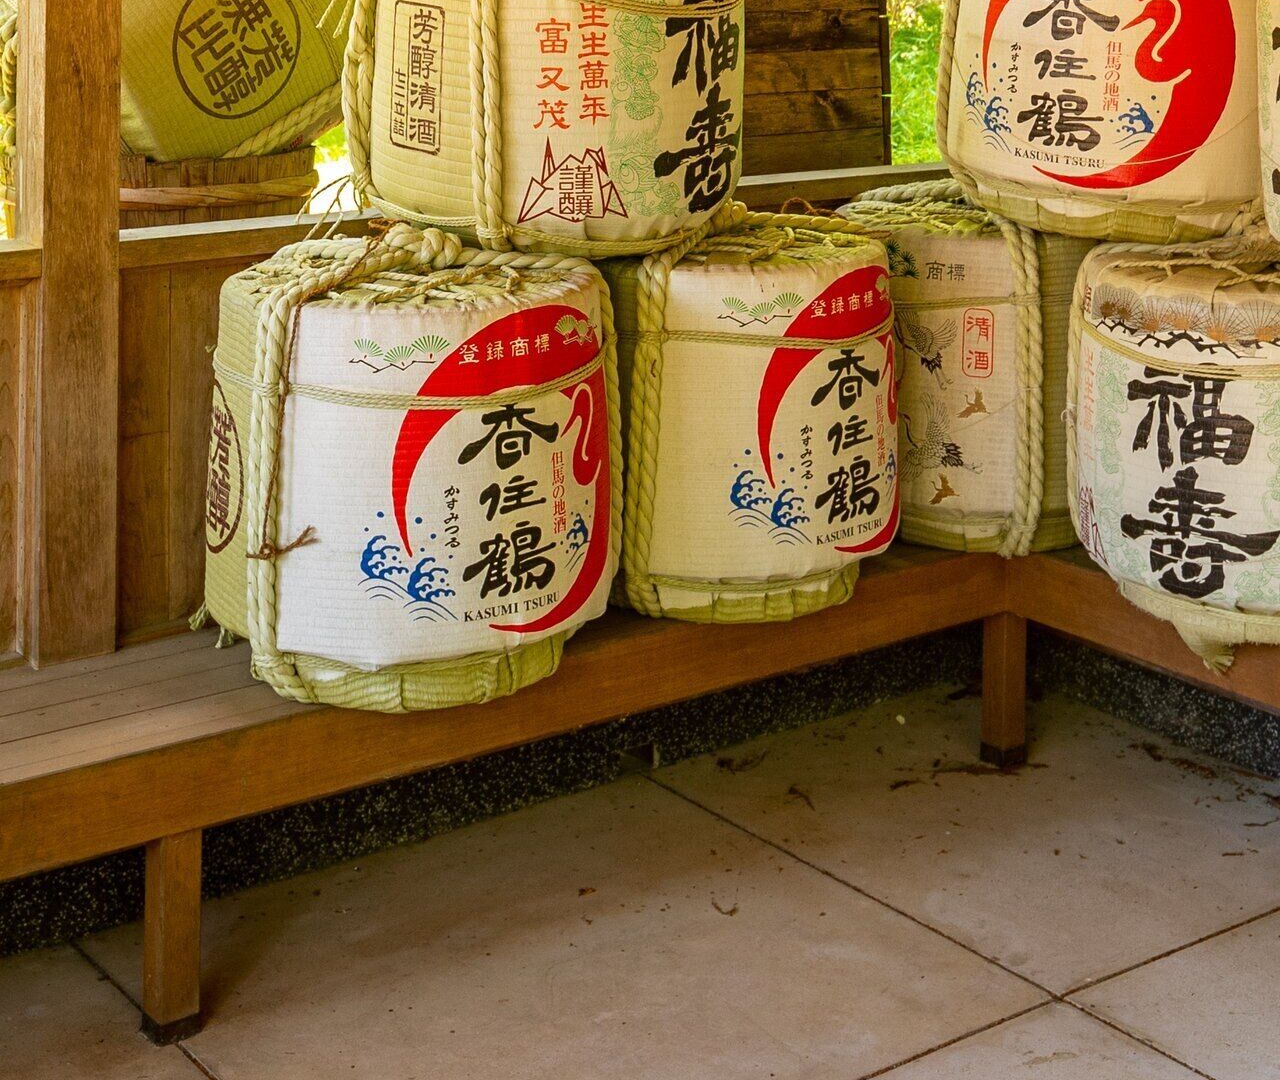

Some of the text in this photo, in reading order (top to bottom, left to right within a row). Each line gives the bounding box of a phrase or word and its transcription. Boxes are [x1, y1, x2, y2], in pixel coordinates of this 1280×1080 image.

[408, 7, 439, 148] 芳醇清酒
[533, 18, 571, 130] 富又茂
[1007, 41, 1023, 94] かすみつる
[1101, 40, 1124, 113] 但馬の地酒
[1013, 147, 1105, 170] KASUMI TSURU
[925, 259, 967, 283] 商標
[810, 290, 874, 320] 登録商標
[457, 332, 551, 366] 登録商標
[966, 314, 992, 373] 清酒
[799, 423, 815, 481] かすみつる
[810, 347, 881, 525] 香住鶴
[874, 393, 887, 469] 但馬の地酒
[443, 484, 462, 549] かすみつる
[458, 402, 560, 600] 香住鶴
[549, 449, 568, 536] 但馬の地酒
[815, 516, 885, 547] KASUMI TSURU
[463, 589, 561, 624] KASUMI TSURU
